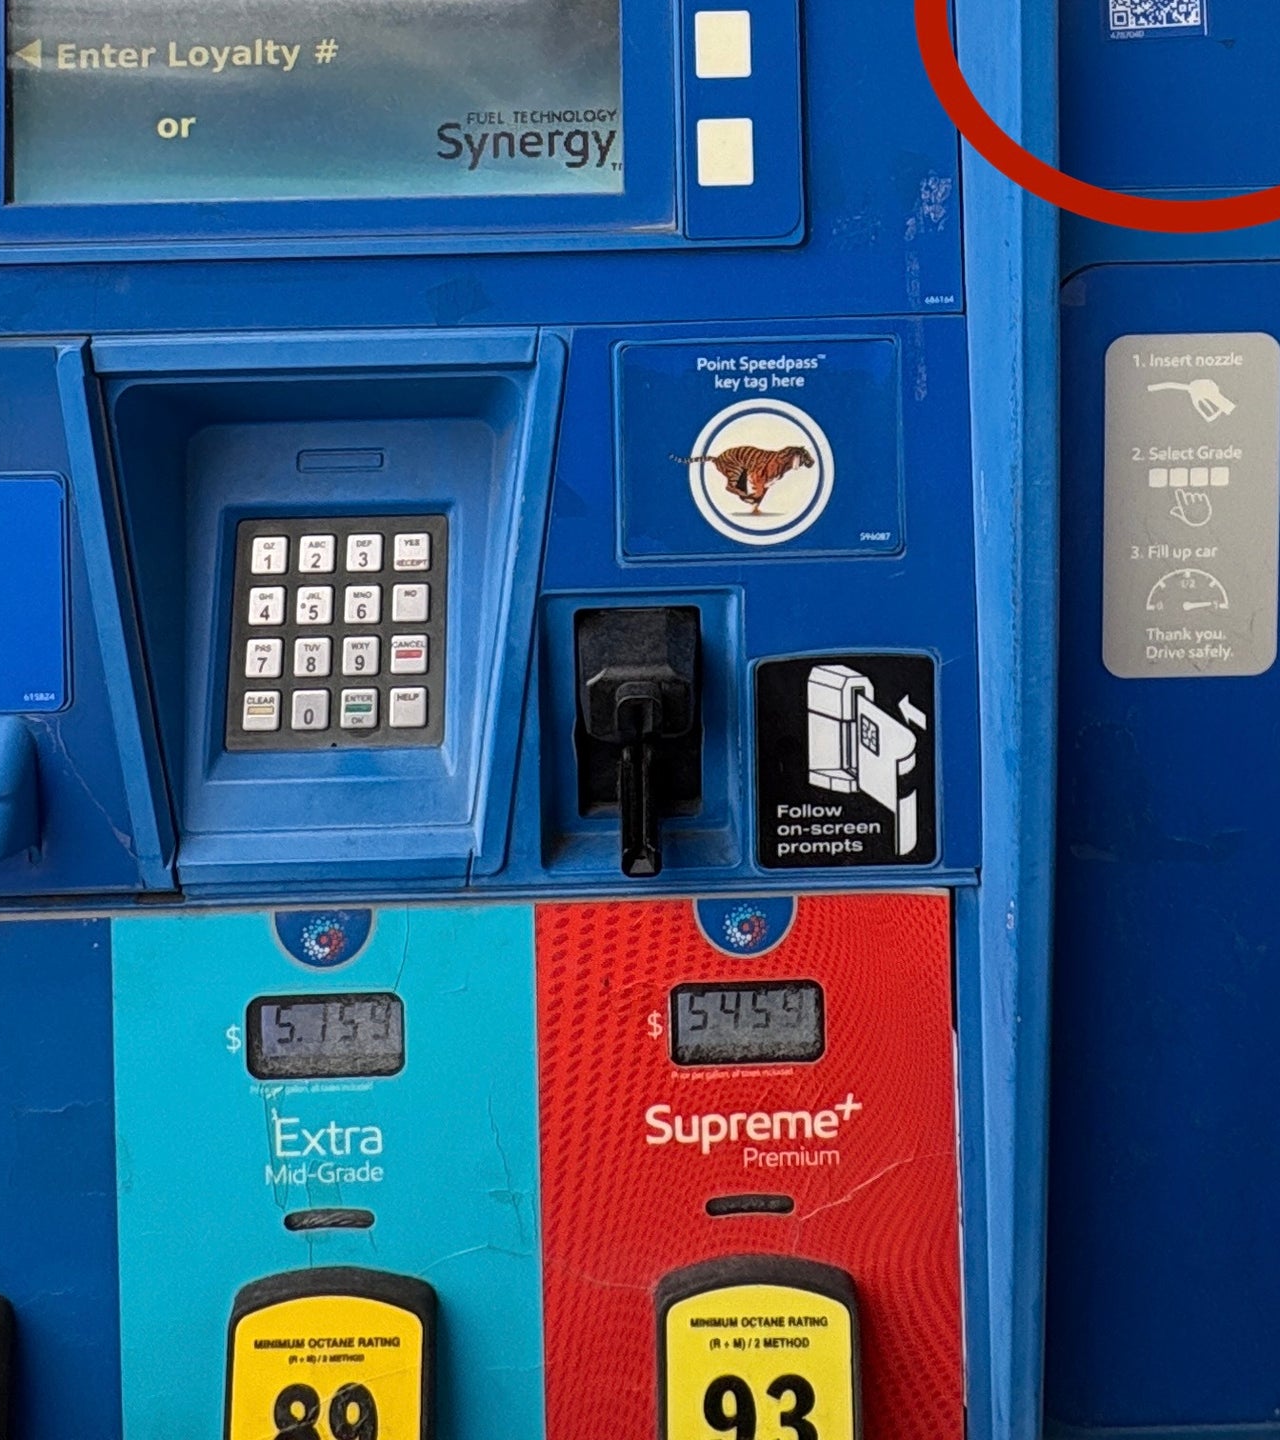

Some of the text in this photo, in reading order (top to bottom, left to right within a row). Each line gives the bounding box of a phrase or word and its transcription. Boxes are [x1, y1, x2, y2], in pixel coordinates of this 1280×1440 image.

[57, 39, 339, 71] Enter Loyalty #
[466, 109, 617, 124] FUEL TECHNOLOGY
[157, 113, 196, 139] or
[437, 122, 617, 169] Synergy
[697, 356, 736, 372] Point
[1133, 353, 1242, 367] 1. Insert nozzle
[715, 373, 805, 391] key tag here
[1198, 446, 1242, 459] Grade
[1131, 545, 1218, 560] 3. Fill up car
[1196, 629, 1226, 642] you.
[1146, 645, 1234, 660] Drive safely.
[247, 696, 274, 705] CLEAR
[777, 804, 842, 818] Follow
[777, 820, 881, 836] on-screen
[777, 838, 863, 855] prompts
[647, 1011, 662, 1040] $
[226, 1025, 241, 1053] $
[275, 1118, 383, 1156] Extra
[744, 1146, 840, 1168] Premium
[266, 1163, 384, 1186] Mid-Grade
[273, 1382, 378, 1440] 89
[703, 1374, 818, 1440] 93
